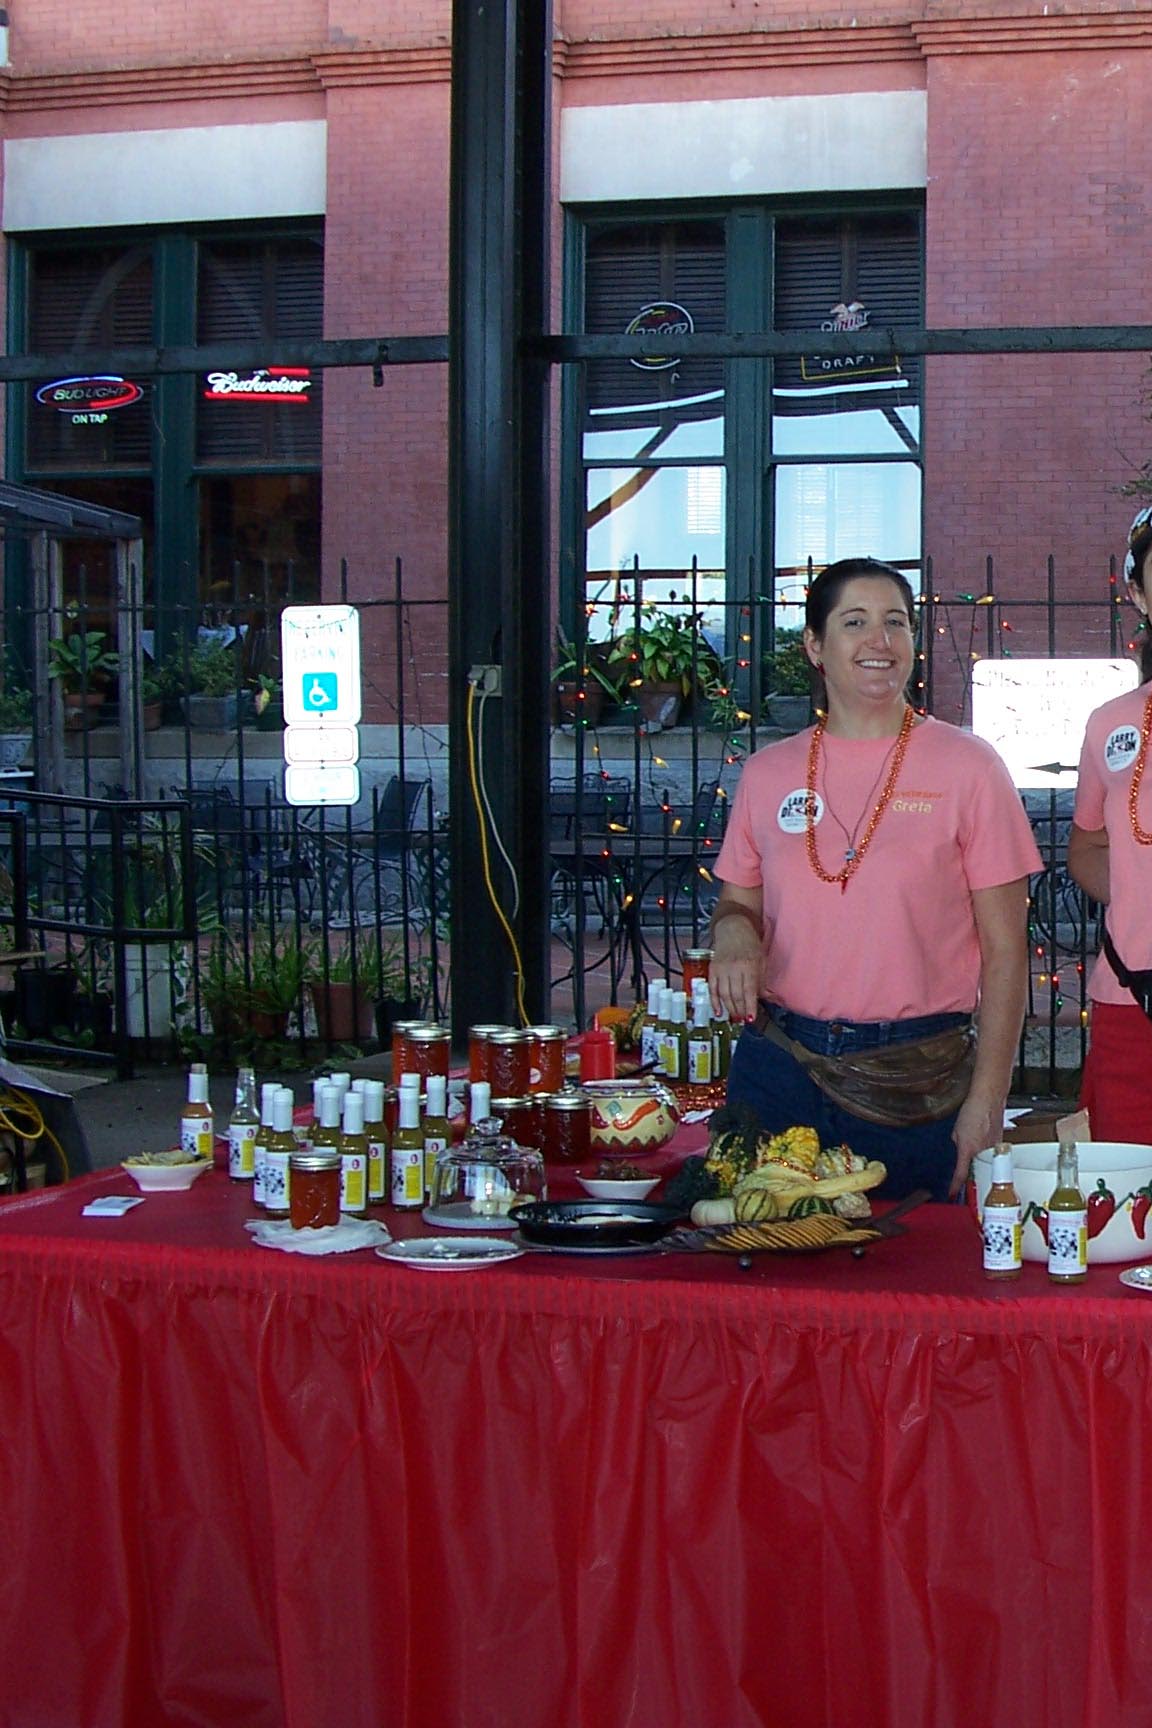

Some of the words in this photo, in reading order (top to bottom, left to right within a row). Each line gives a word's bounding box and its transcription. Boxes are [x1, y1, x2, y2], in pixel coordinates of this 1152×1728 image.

[207, 371, 312, 395] Budweiser
[53, 389, 84, 401] BUD
[85, 386, 127, 399] LIGHT
[71, 414, 88, 425] ON
[89, 413, 109, 424] TAP
[892, 799, 932, 814] Greta
